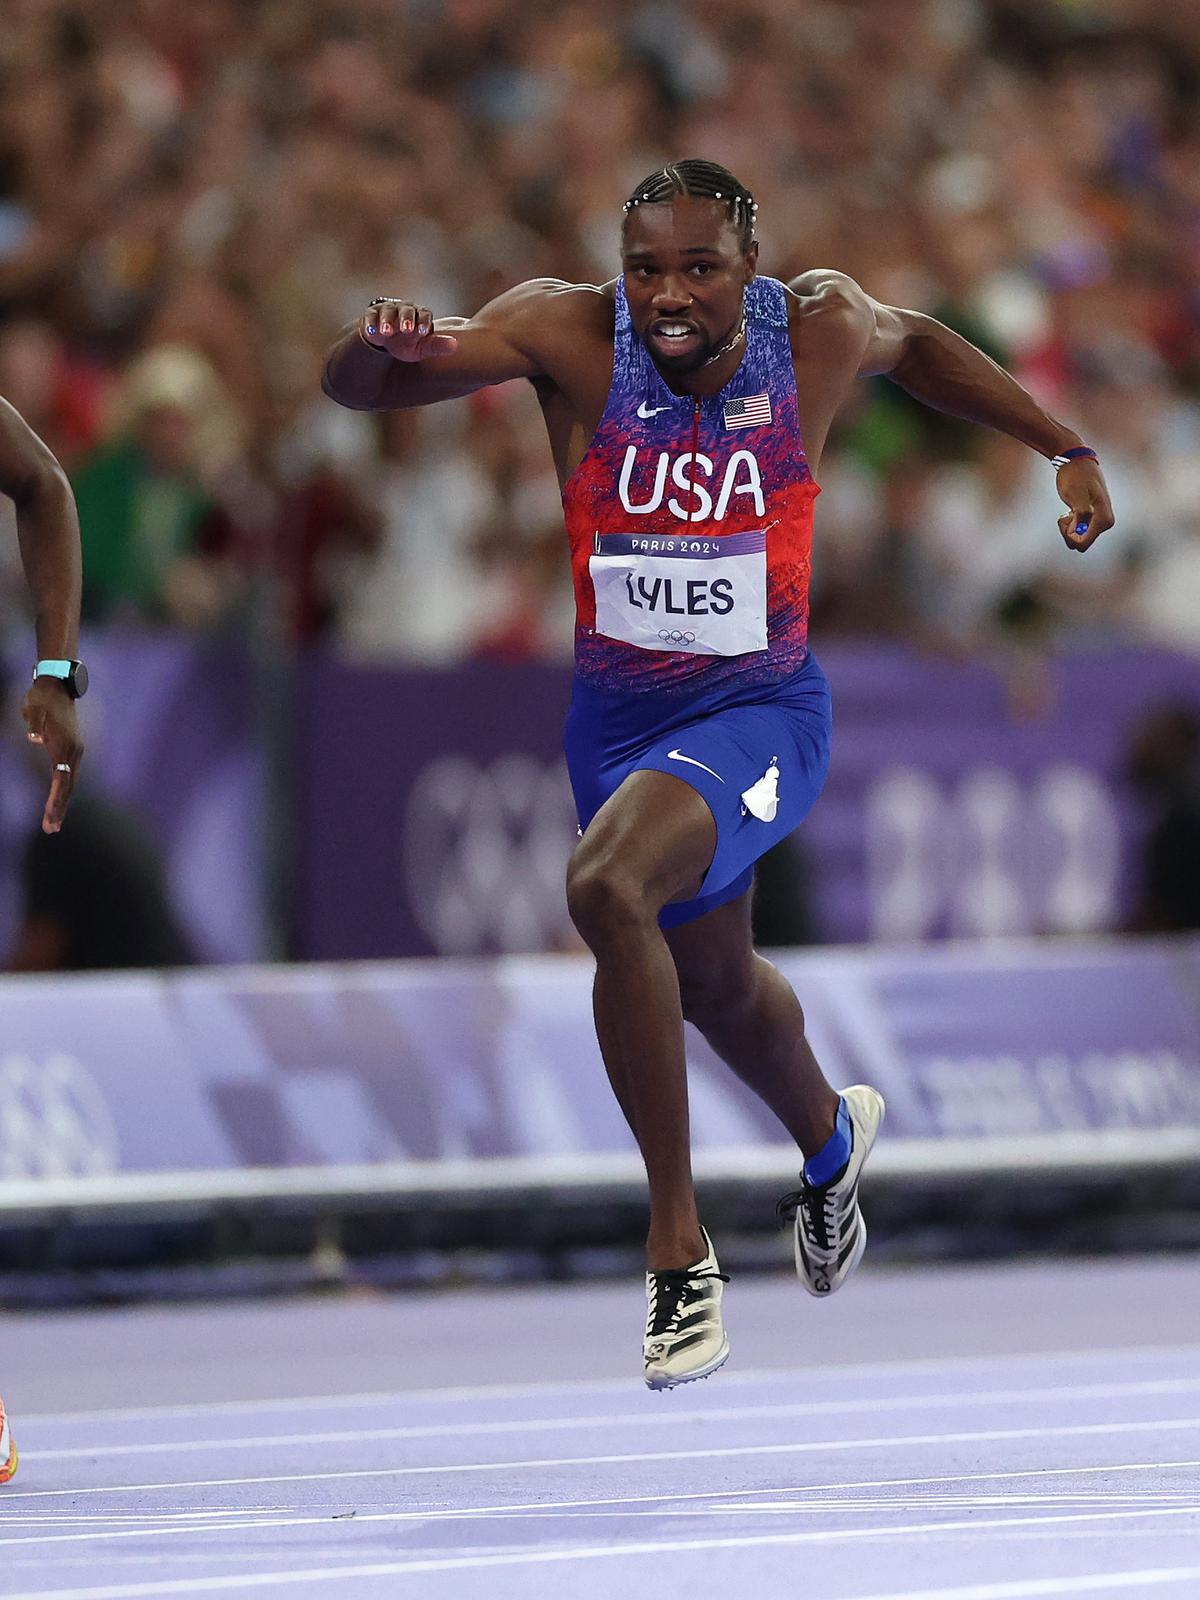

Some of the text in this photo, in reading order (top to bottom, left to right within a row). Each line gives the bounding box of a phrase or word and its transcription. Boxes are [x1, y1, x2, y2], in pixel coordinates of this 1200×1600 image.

[618, 445, 766, 522] USA
[631, 539, 720, 553] PARIS 2024
[625, 572, 735, 615] LYLES
